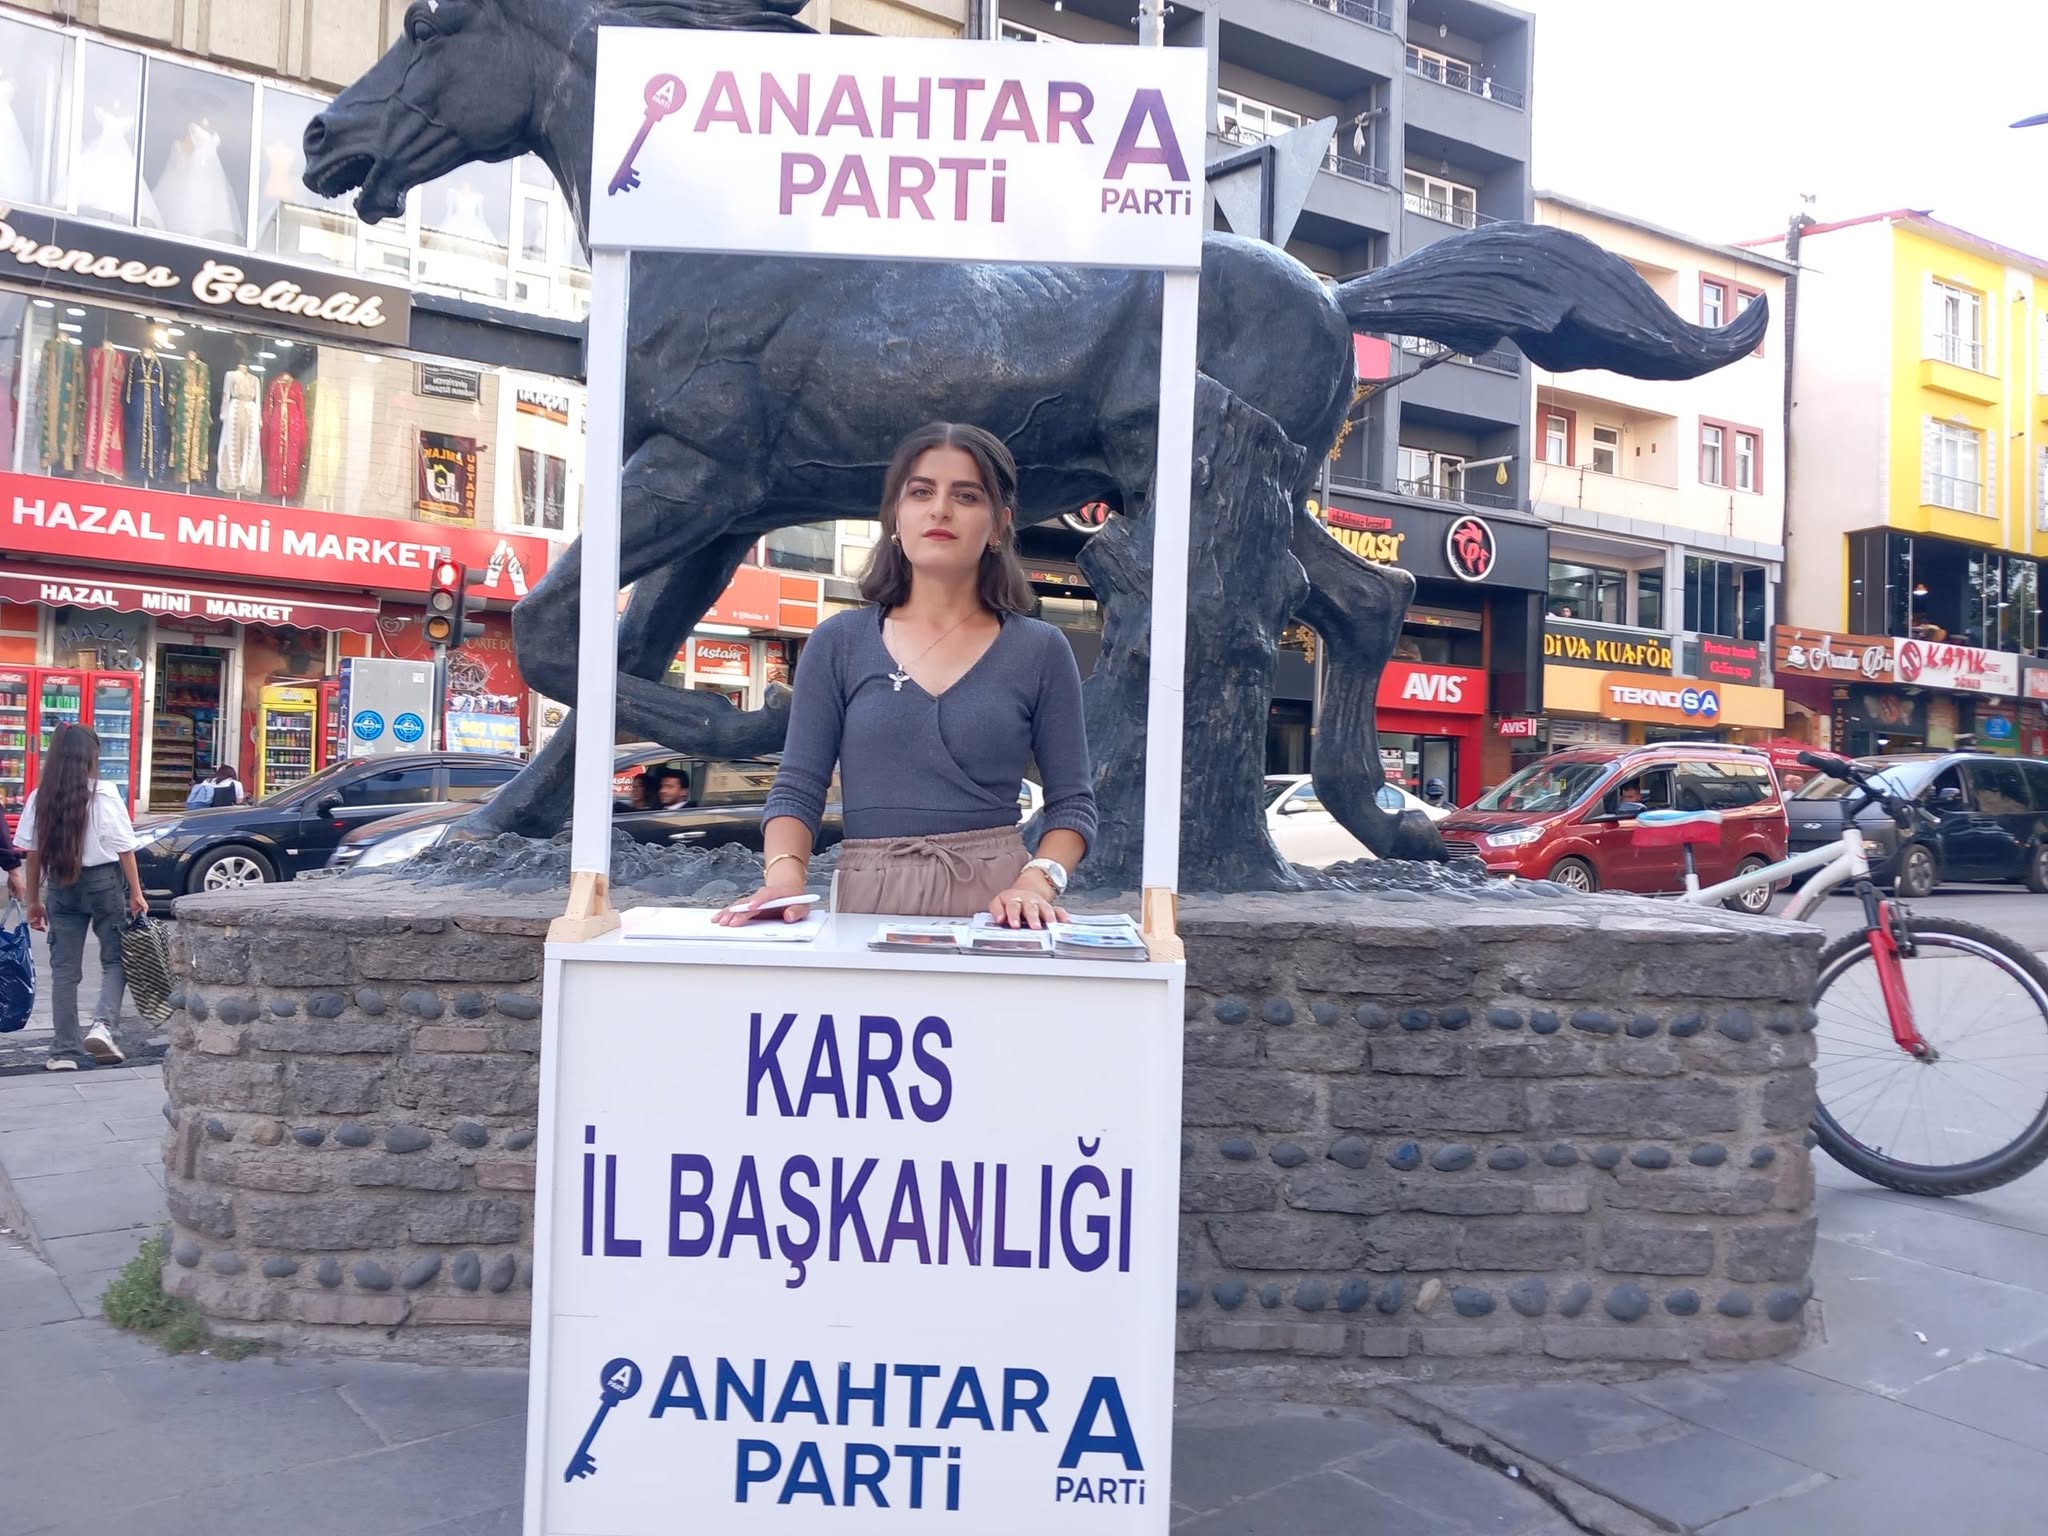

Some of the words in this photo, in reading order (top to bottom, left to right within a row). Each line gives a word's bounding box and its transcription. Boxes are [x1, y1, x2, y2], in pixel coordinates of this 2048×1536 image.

[694, 71, 1094, 144] ANAHTAR
[1102, 88, 1191, 182] A
[12, 497, 165, 541] HAZAL
[282, 529, 442, 571] MARKET
[40, 584, 119, 607] HAZAL
[206, 600, 293, 621] MARKET
[1401, 672, 1464, 703] AVIS
[1595, 639, 1672, 669] KUAFÖR
[1926, 643, 1987, 675] KATIK
[1501, 721, 1528, 734] AVIS
[1609, 685, 1719, 717] TEKNOSA
[745, 1012, 953, 1123] KARS
[582, 1125, 642, 1258] İL
[667, 1137, 1133, 1289] BAŞKANLIĞI
[649, 1355, 1050, 1433] ANAHTAR
[1057, 1376, 1145, 1471] A
